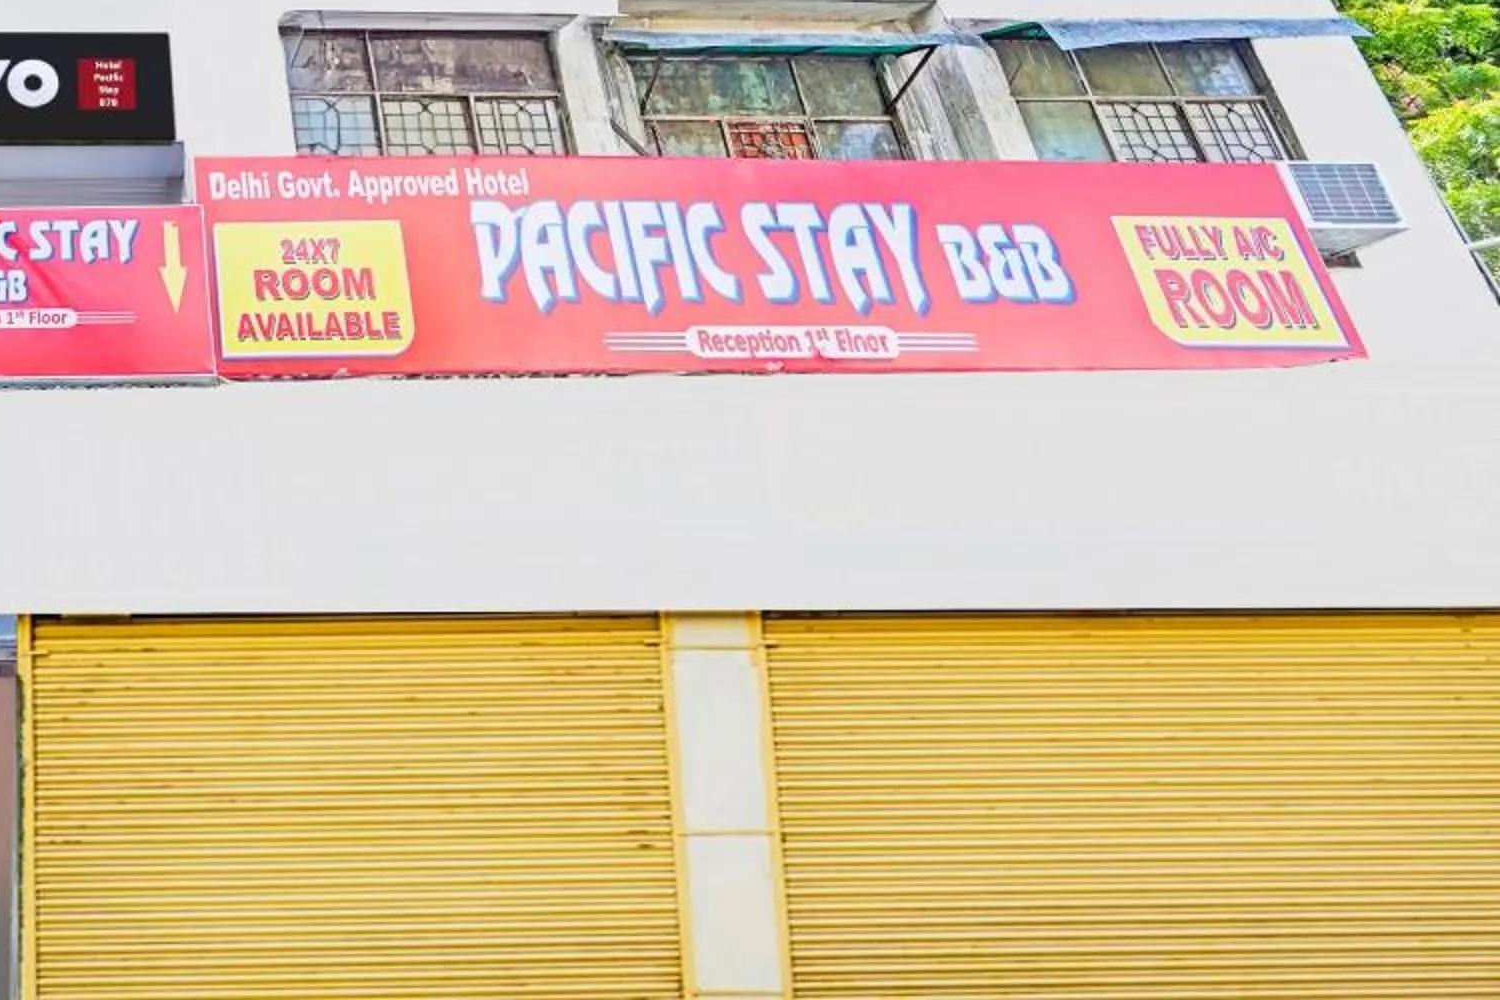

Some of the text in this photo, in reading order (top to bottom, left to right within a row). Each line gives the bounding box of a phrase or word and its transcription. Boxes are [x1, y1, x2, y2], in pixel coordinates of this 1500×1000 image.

[95, 60, 122, 70] Hotel
[209, 168, 530, 205] Delhi Govt. Approved Hotel
[29, 219, 140, 264] STAY
[469, 199, 1079, 318] PACIFIC STAY B&B
[1134, 224, 1229, 260] FULLY
[253, 267, 377, 301] ROOM
[1153, 268, 1322, 330] ROOM
[29, 310, 67, 325] Floor
[237, 310, 402, 343] AVAILABLE
[696, 329, 800, 358] Reception
